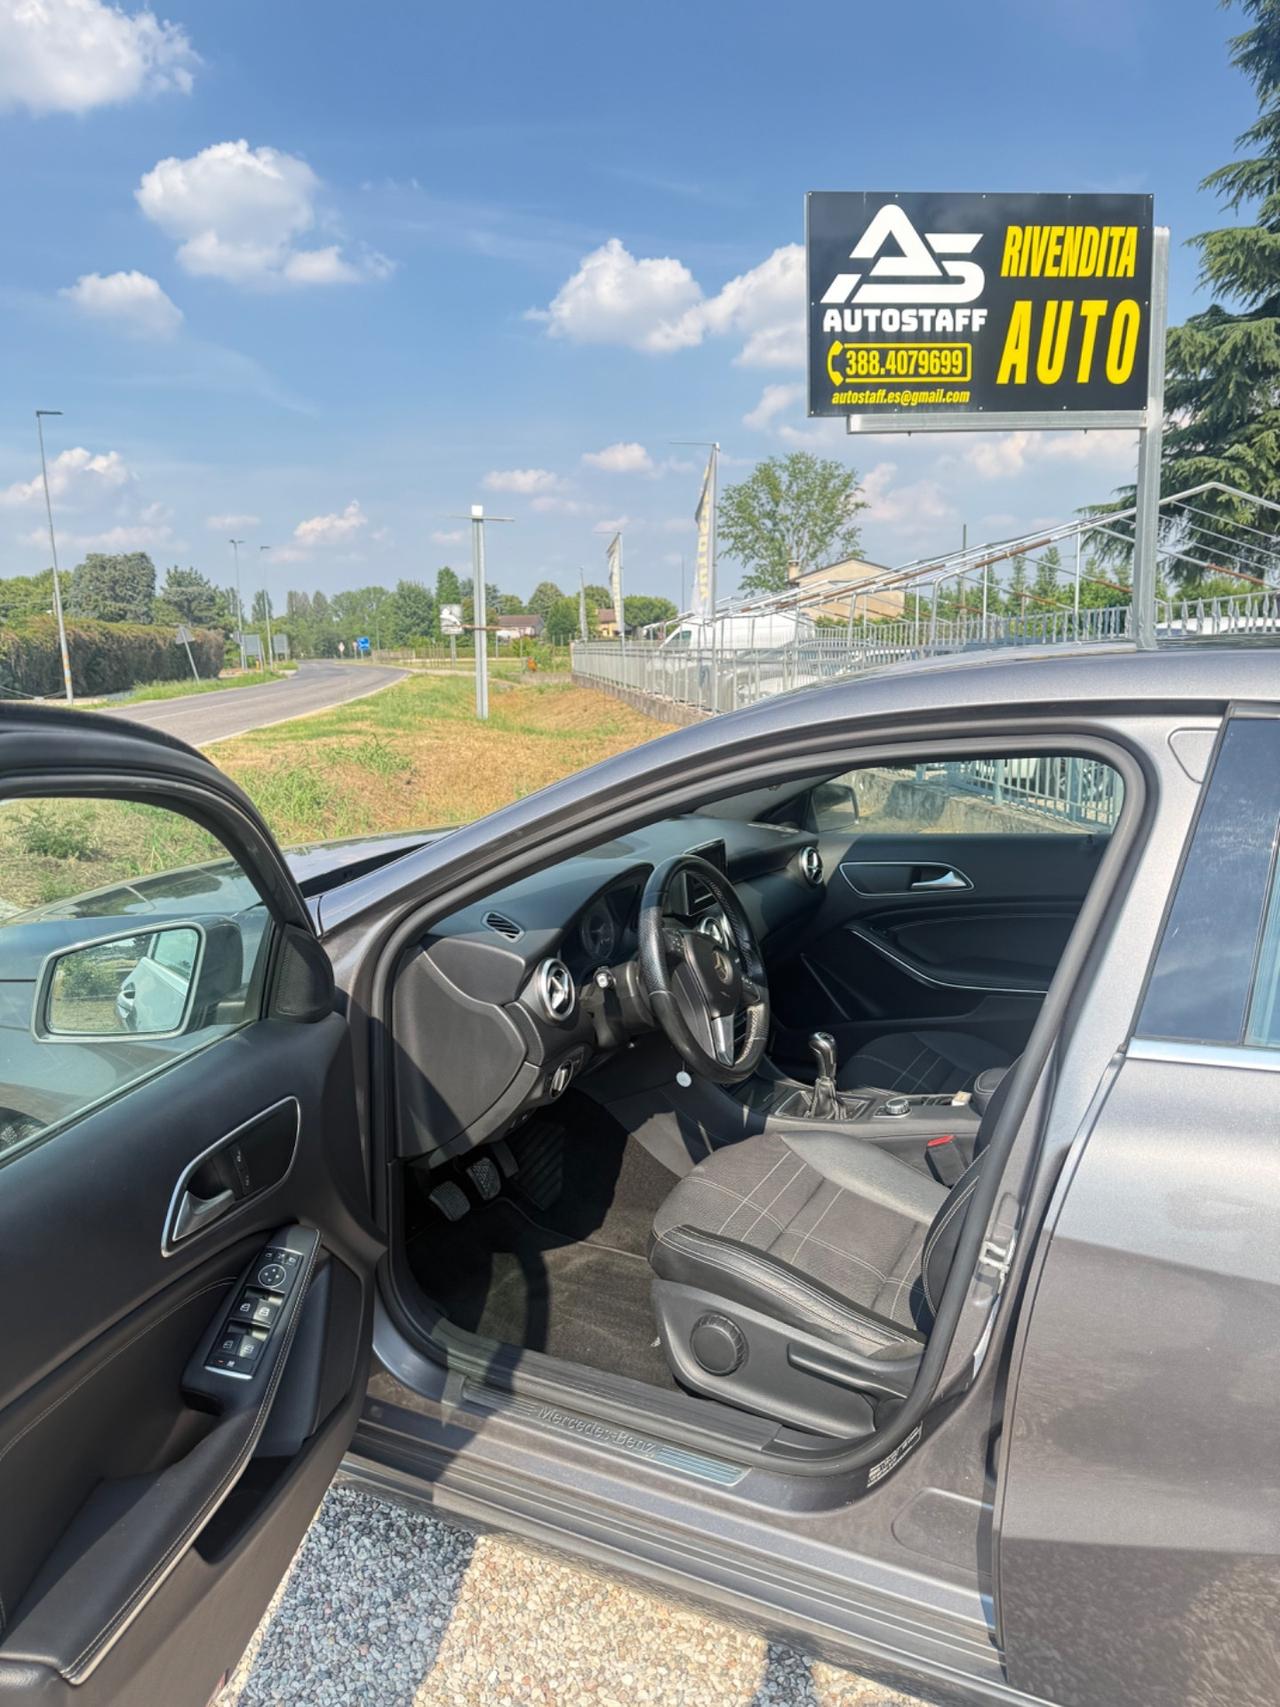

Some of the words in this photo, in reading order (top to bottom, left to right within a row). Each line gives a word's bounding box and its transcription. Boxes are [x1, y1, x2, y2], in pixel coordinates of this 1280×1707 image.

[1000, 225, 1139, 278] RIVENDITA
[822, 308, 988, 333] AUTOSTAFF
[996, 298, 1142, 385] AUTO
[845, 349, 963, 376] 388.4079699
[831, 388, 971, 406] autostaff.es@gmail.com
